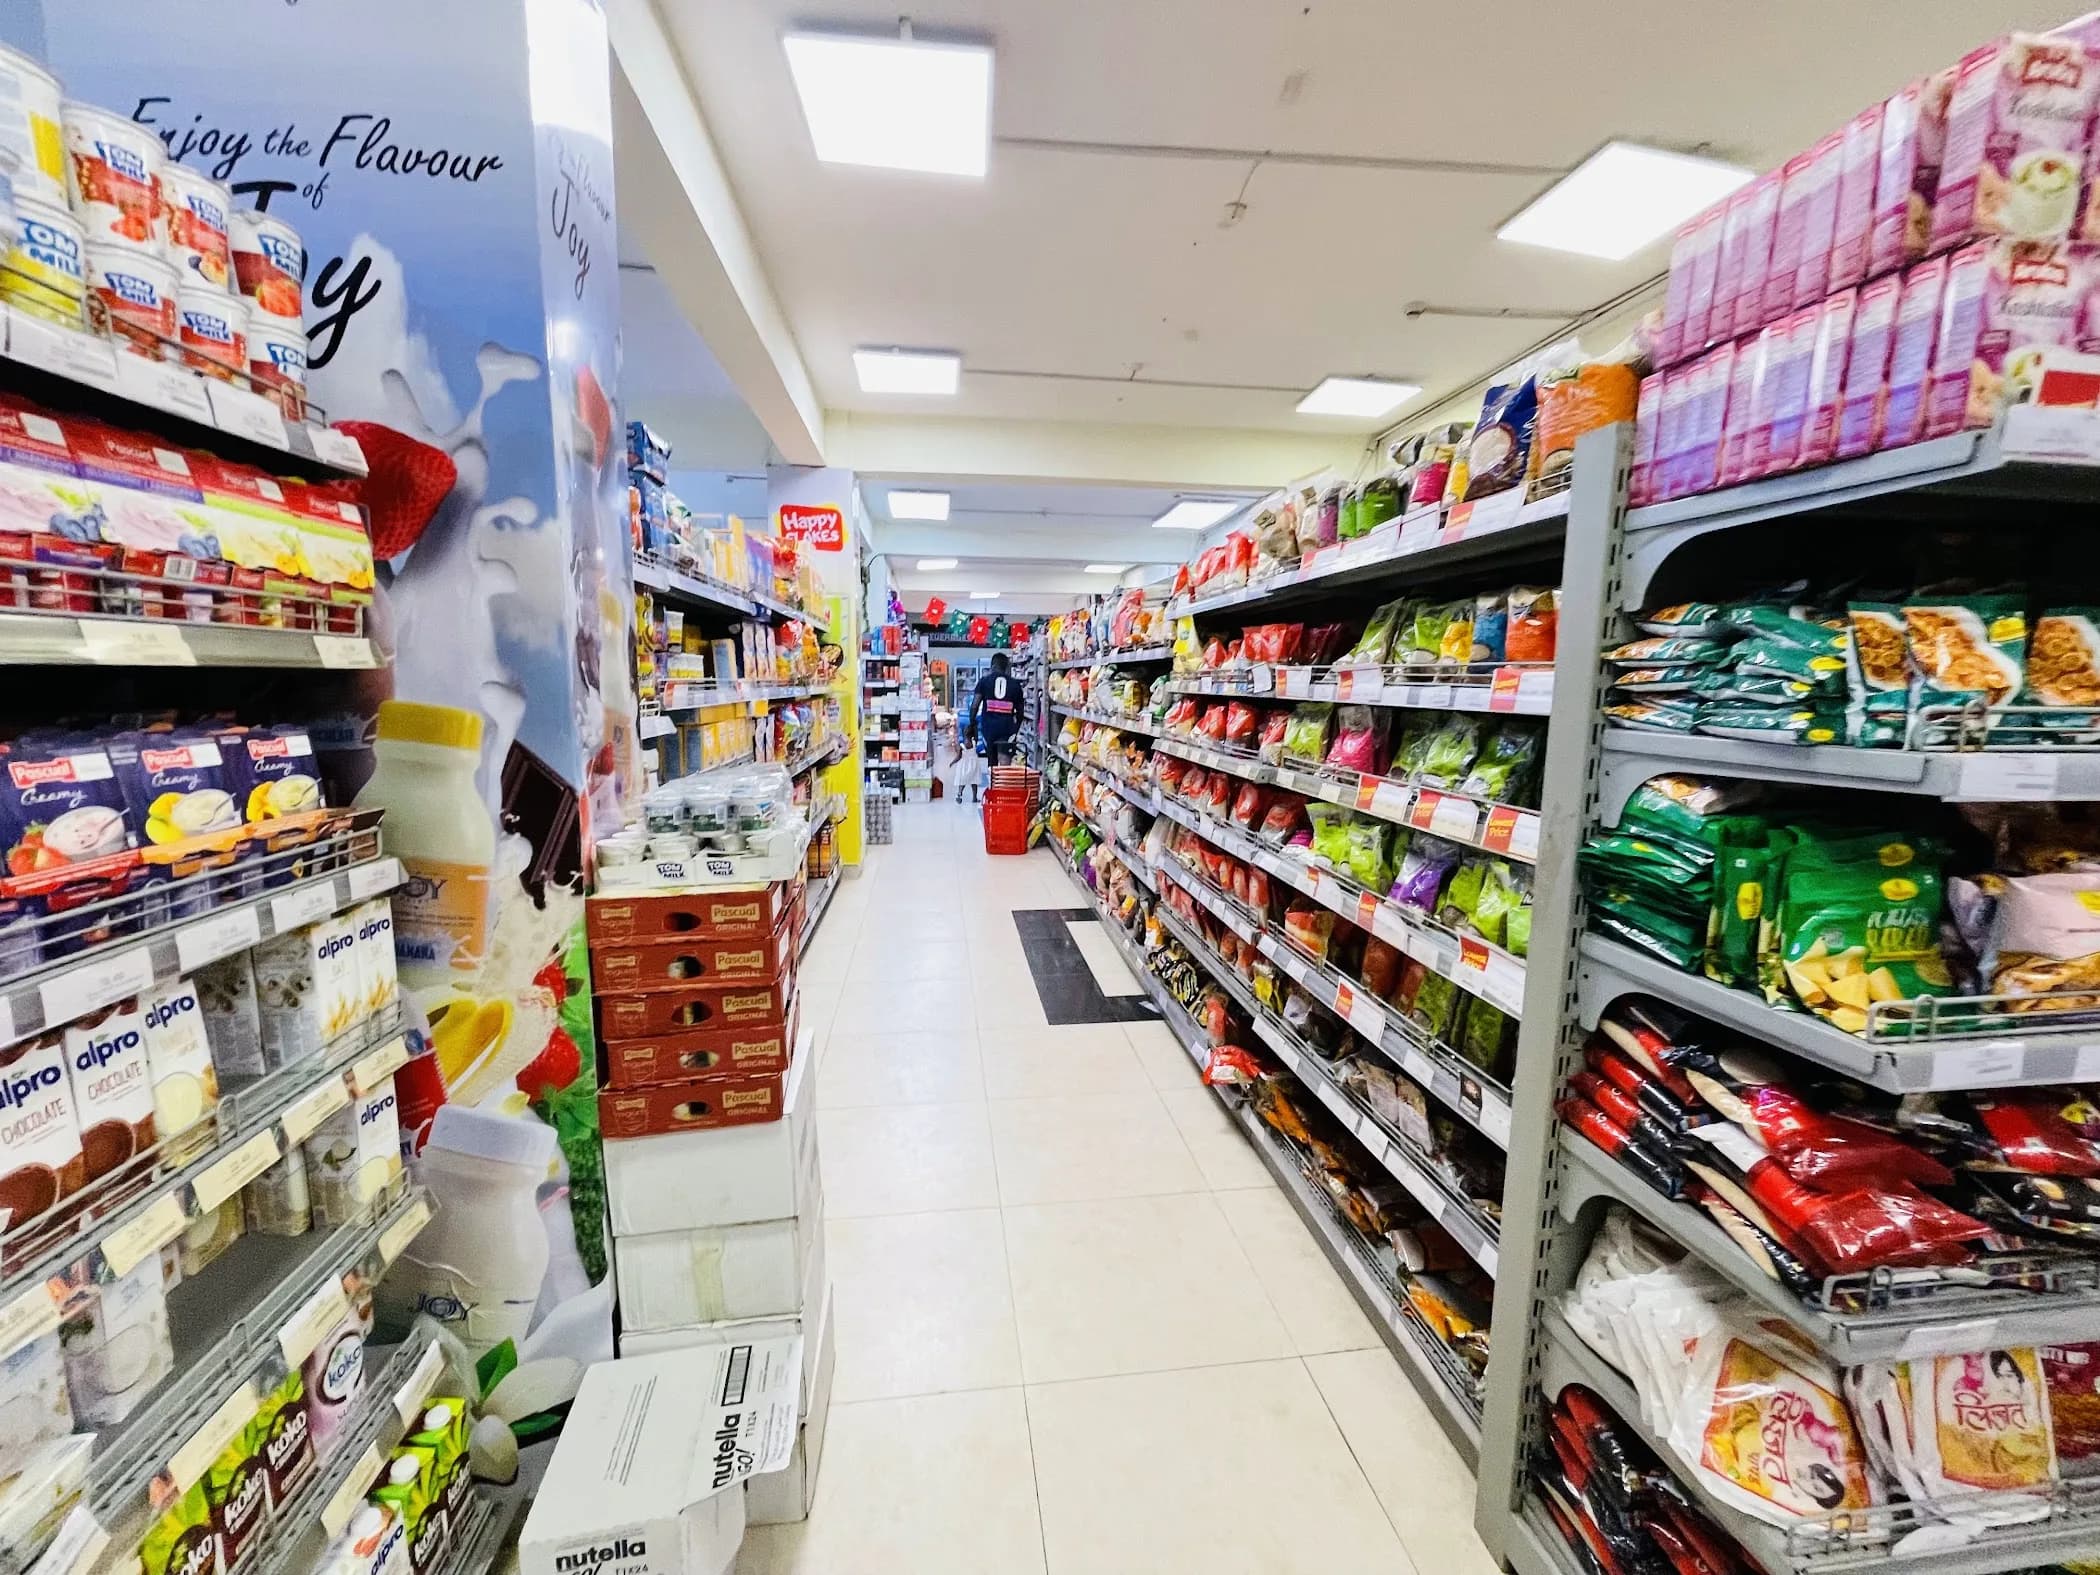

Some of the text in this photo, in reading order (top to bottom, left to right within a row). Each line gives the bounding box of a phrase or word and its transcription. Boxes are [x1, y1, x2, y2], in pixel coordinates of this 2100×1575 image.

[264, 124, 312, 157] the
[319, 114, 503, 182] Flavour
[303, 172, 329, 210] of
[552, 170, 591, 300] Joy
[107, 273, 153, 294] TOM
[187, 312, 226, 331] TOM
[193, 325, 231, 341] MILK
[782, 511, 838, 532] Happy
[145, 751, 191, 769] Pascual
[254, 759, 295, 776] Creamy
[15, 764, 70, 784] Pascual
[151, 771, 201, 790] Creamy
[20, 787, 88, 808] Creamy
[657, 863, 681, 872] TOM
[663, 870, 684, 878] MILK
[707, 861, 730, 870] TOM
[713, 868, 734, 876] MILK
[714, 904, 757, 918] Pascual
[358, 915, 391, 942] alpro
[318, 931, 354, 960] alpro
[718, 951, 761, 966] Pascual
[725, 993, 769, 1009] Pascual
[144, 995, 196, 1030] alpro
[76, 1030, 140, 1072] alpro
[734, 1041, 778, 1055] Pascual
[0, 1065, 62, 1110] lpro
[88, 1059, 143, 1102] CHOCOLATE
[725, 1089, 768, 1103] Pascual
[360, 1094, 395, 1126] alpro
[1, 1097, 67, 1145] CHOCOLATE
[328, 1344, 361, 1388] koko
[712, 1413, 742, 1490] nutella
[371, 1524, 405, 1575] alpro
[555, 1539, 647, 1573] nutella
